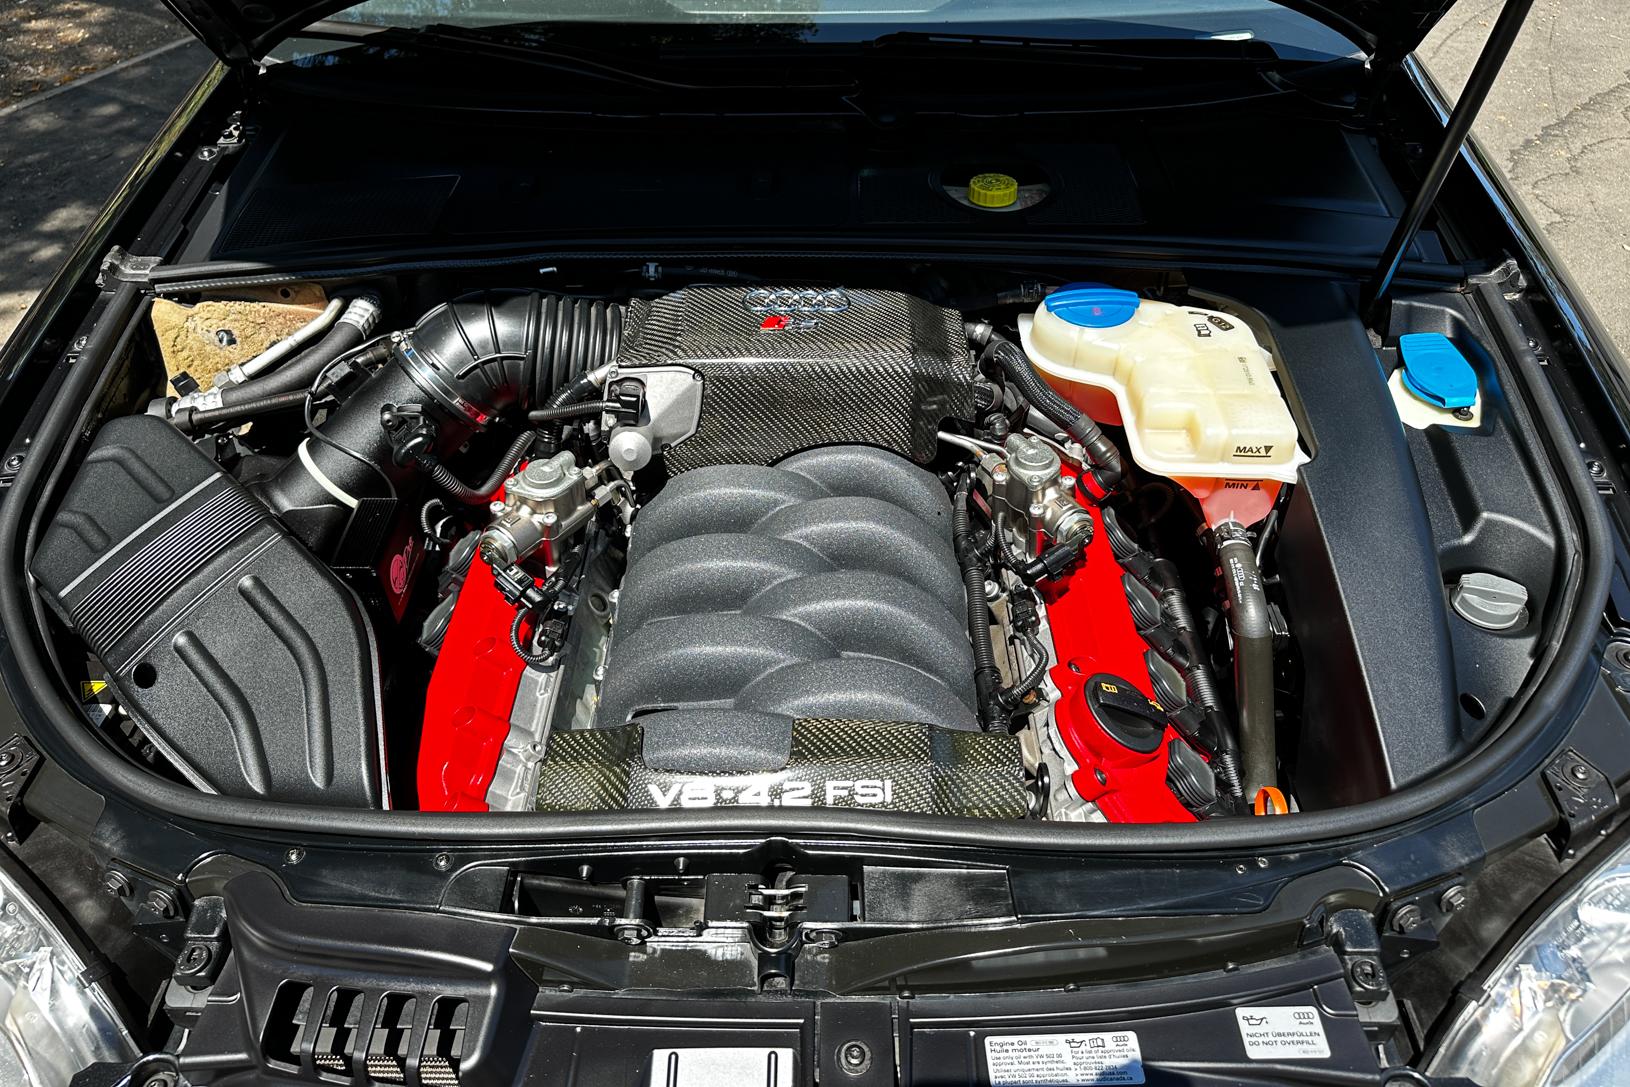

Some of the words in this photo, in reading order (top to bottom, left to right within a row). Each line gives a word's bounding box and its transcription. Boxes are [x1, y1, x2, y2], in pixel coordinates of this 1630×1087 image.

[1235, 446, 1263, 454] MAX
[1224, 482, 1249, 490] MIN
[825, 779, 892, 806] FSI
[1271, 1030, 1321, 1038] ÜBERFÜLLEN
